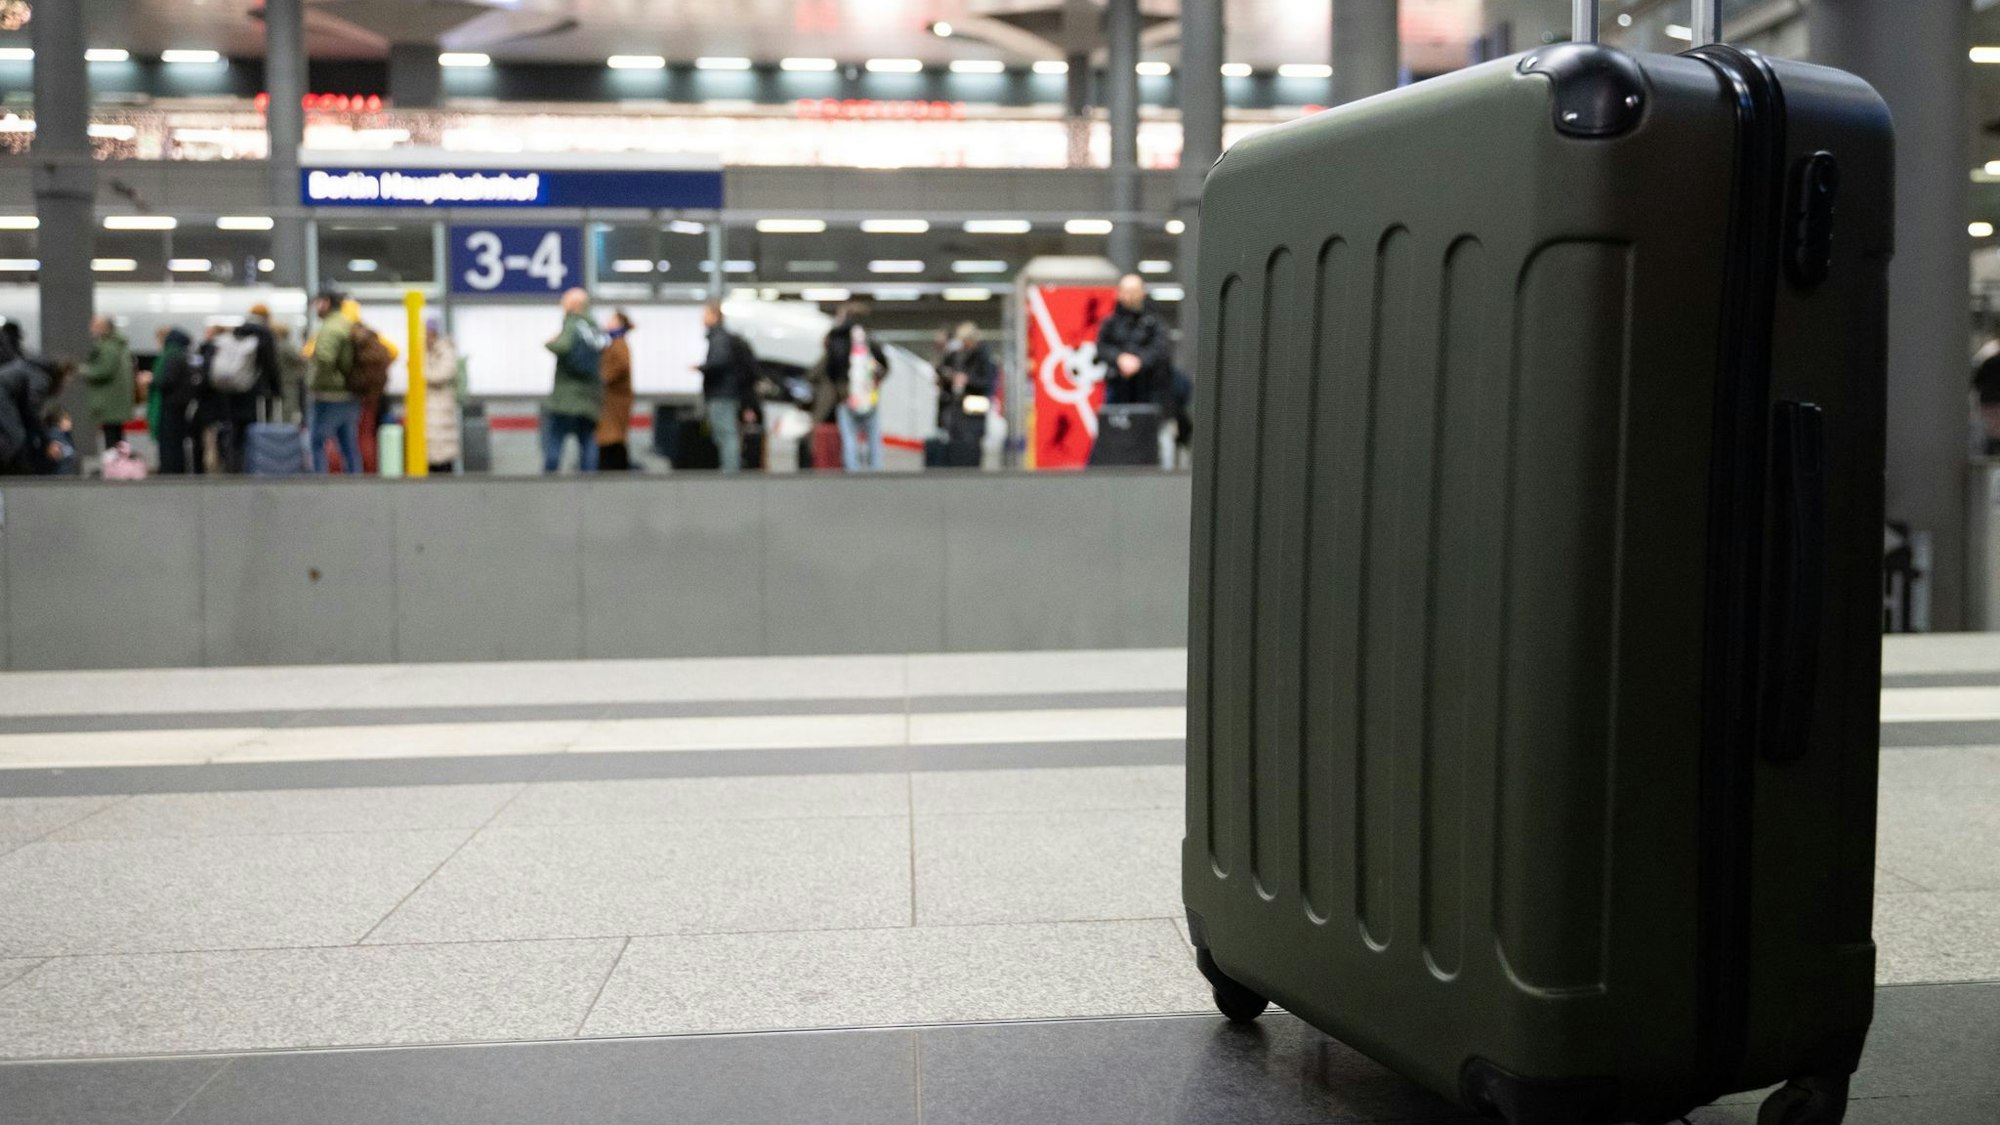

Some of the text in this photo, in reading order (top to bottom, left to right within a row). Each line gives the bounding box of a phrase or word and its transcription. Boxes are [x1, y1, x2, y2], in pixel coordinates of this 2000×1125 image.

[309, 171, 539, 204] Berlin Hauptbahnhof
[464, 231, 568, 289] 3-4
